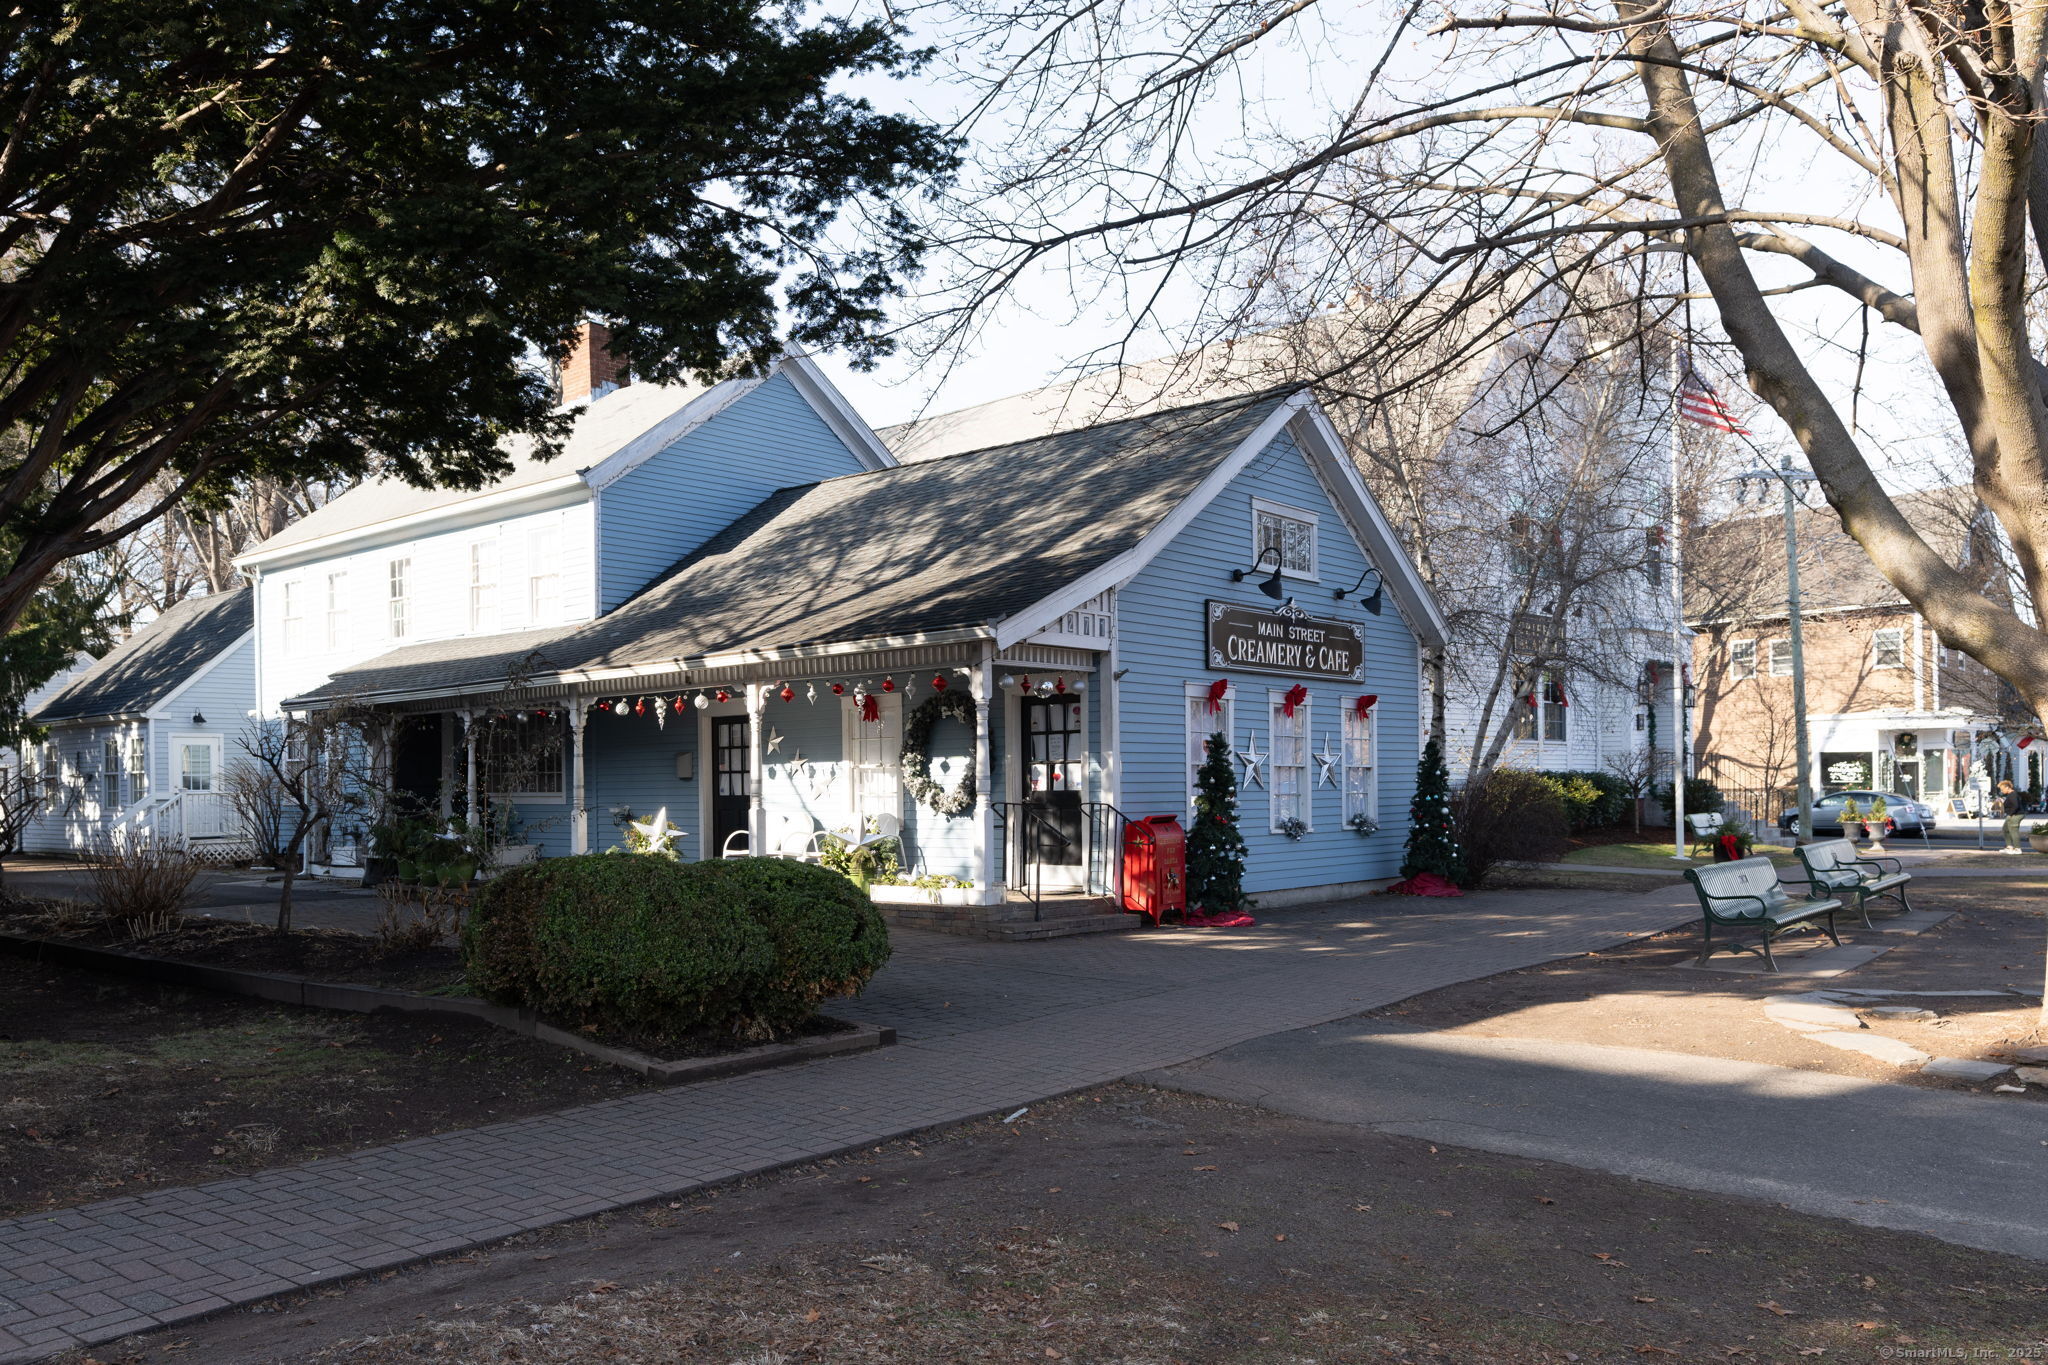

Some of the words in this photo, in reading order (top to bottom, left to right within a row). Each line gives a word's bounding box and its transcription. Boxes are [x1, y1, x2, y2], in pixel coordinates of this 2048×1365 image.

[1258, 621, 1284, 638] MAIN
[1288, 627, 1326, 643] STREET
[1227, 634, 1302, 667] CREAMERY
[1305, 645, 1316, 668] &
[1318, 646, 1350, 672] CAFE
